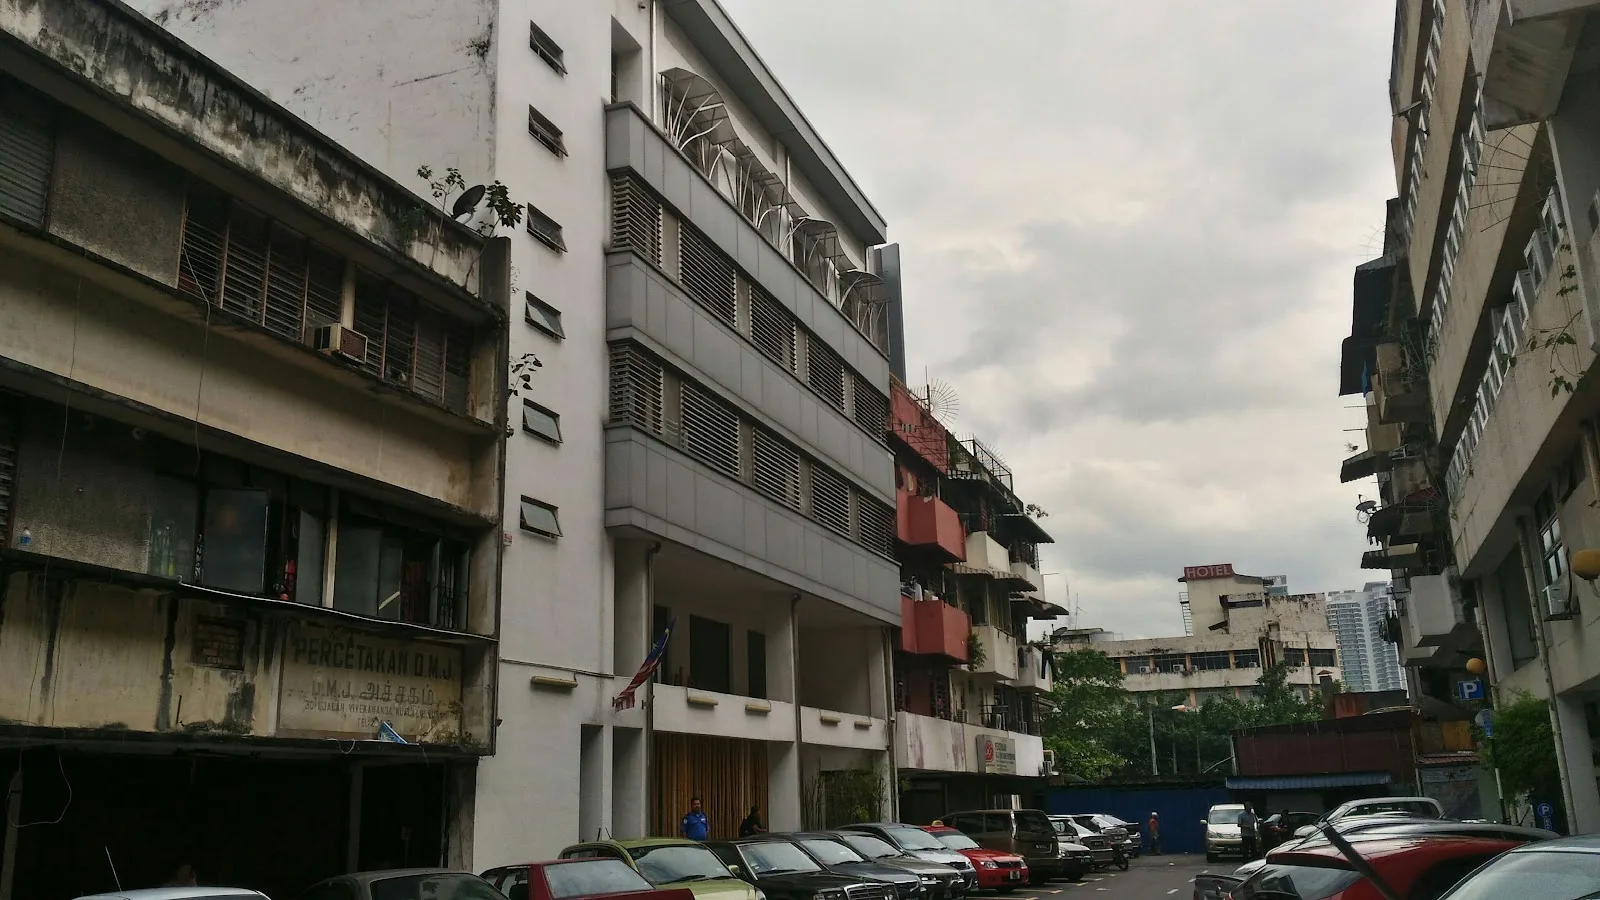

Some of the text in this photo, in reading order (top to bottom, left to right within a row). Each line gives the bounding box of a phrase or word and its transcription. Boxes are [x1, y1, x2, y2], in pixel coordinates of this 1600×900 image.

[1186, 565, 1232, 578] HOTEL
[294, 637, 408, 675] PERCETAKAN
[1462, 682, 1478, 698] P
[1541, 805, 1550, 815] P
